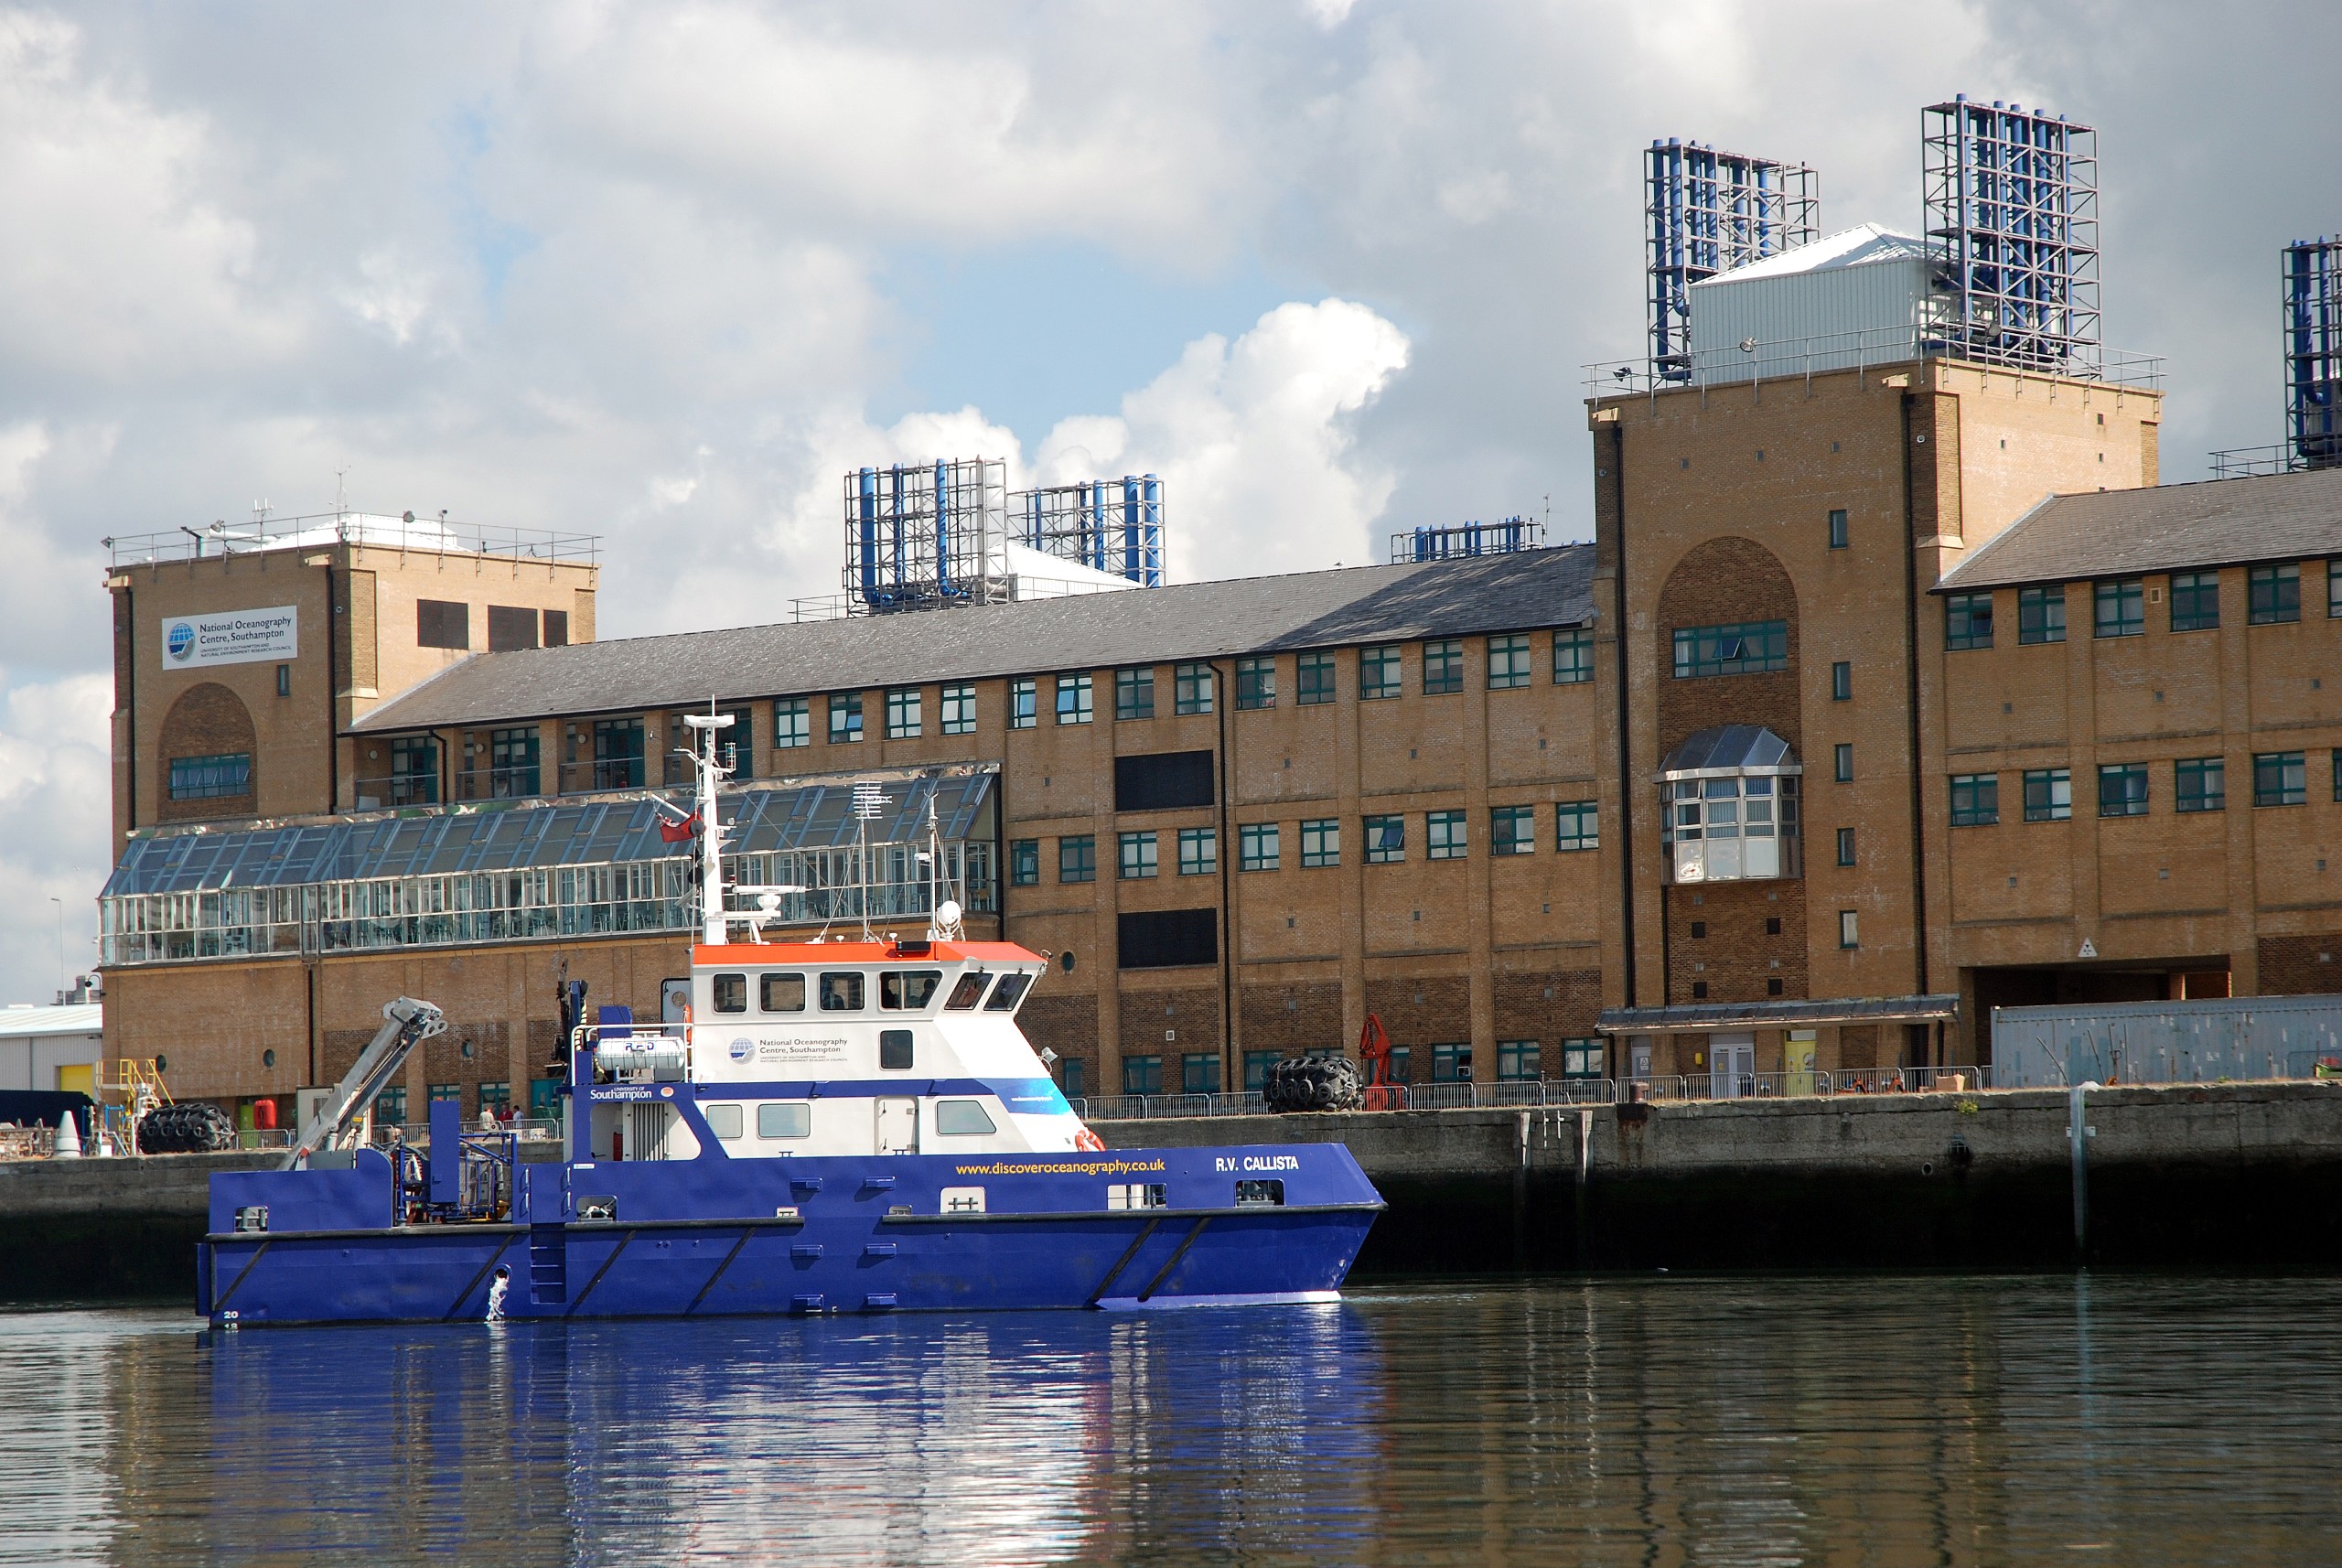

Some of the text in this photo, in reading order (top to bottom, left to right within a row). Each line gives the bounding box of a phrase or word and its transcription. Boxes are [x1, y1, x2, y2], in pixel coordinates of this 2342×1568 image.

[200, 617, 291, 633] National Oceanography
[200, 630, 285, 644] Centre, Southampton
[794, 1038, 848, 1047] Oceanography
[590, 1090, 652, 1101] Southampton
[956, 1159, 1165, 1176] www.discoveroceanography.co.uk
[1215, 1156, 1299, 1171] R.V. CALLISTA
